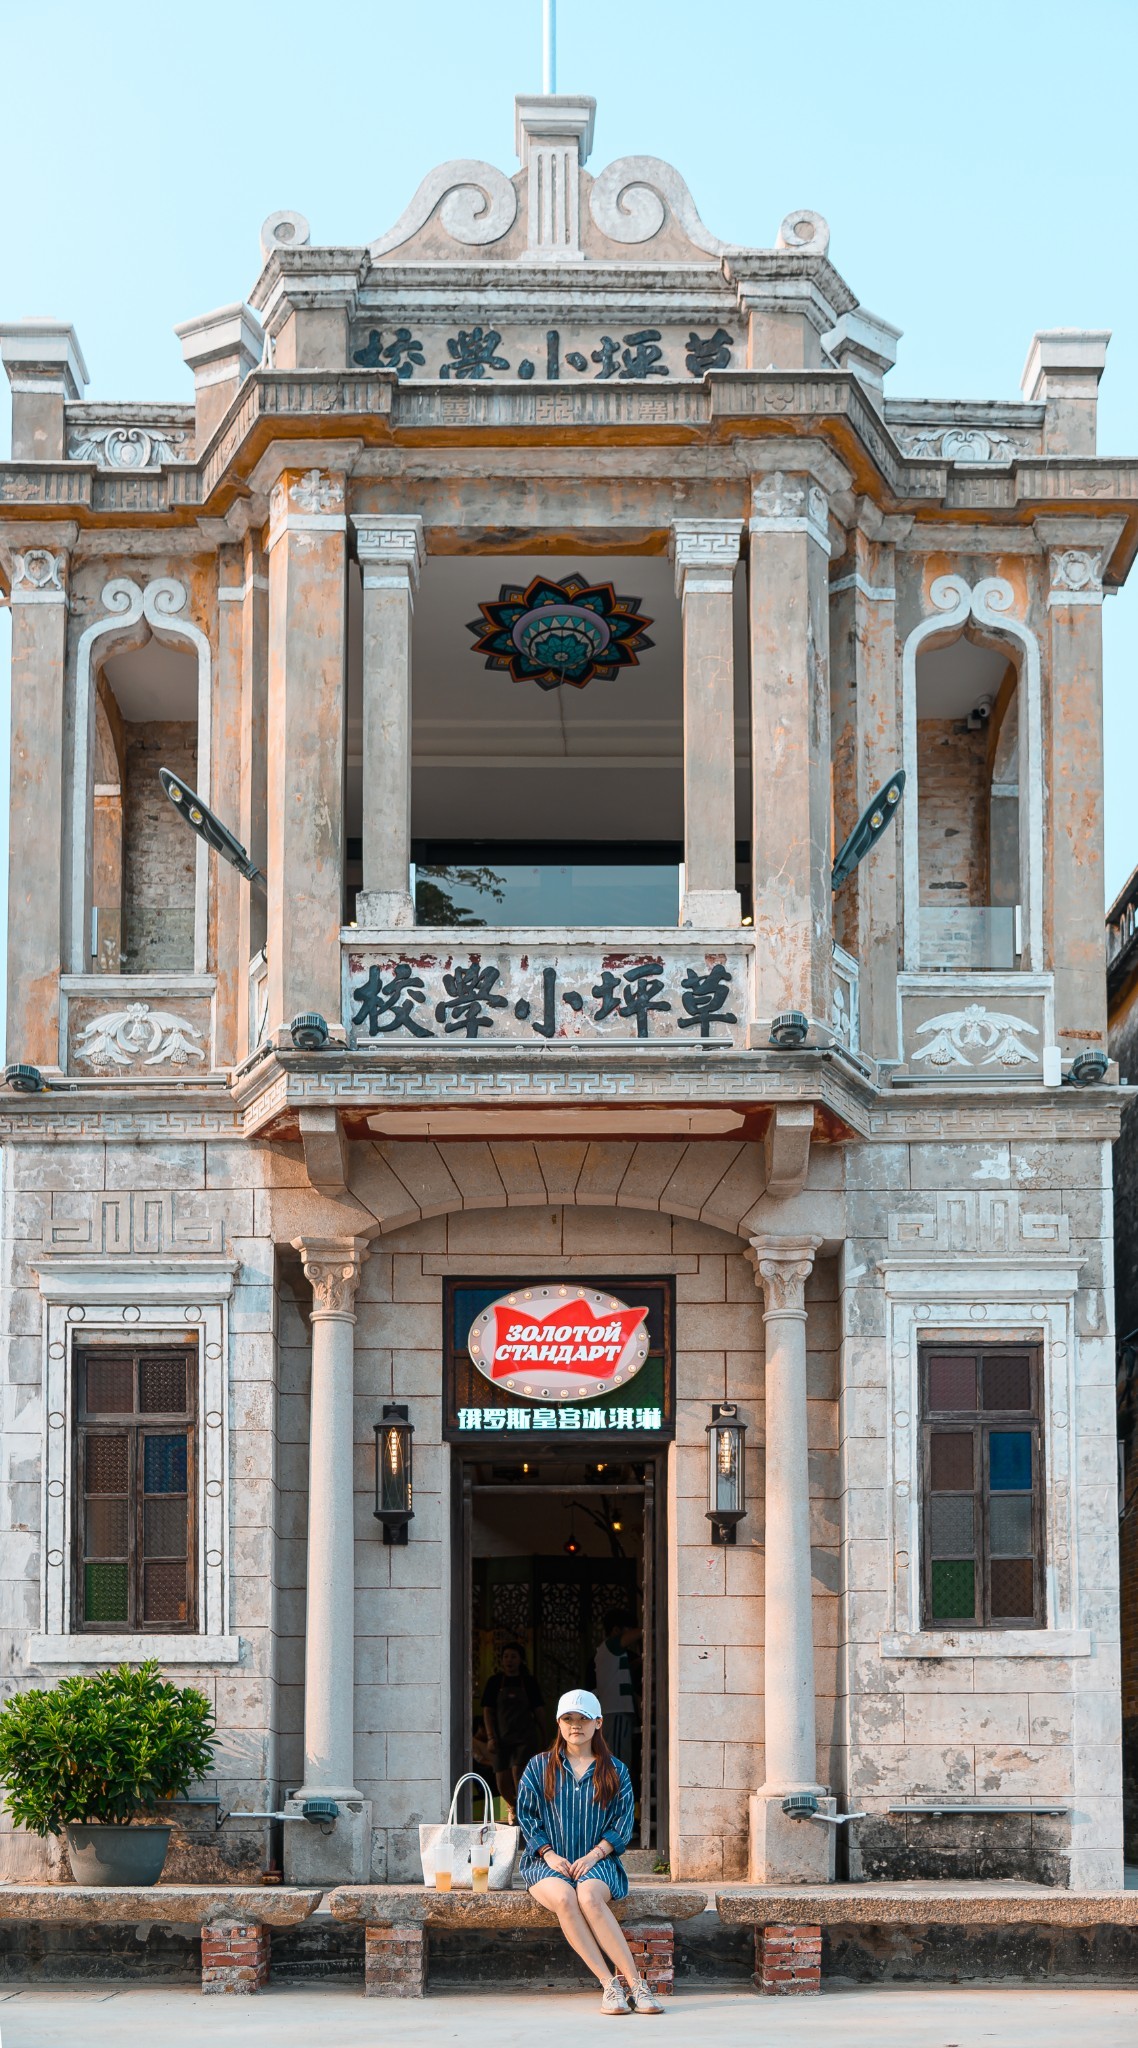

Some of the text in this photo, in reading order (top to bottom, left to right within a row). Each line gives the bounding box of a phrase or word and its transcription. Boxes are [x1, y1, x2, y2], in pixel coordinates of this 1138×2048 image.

[506, 1321, 622, 1342] ЗОЛОТОЙ
[495, 1345, 622, 1364] СТАНДАРТ
[457, 1407, 662, 1430] 俄罗斯皇宫冰淇淋
